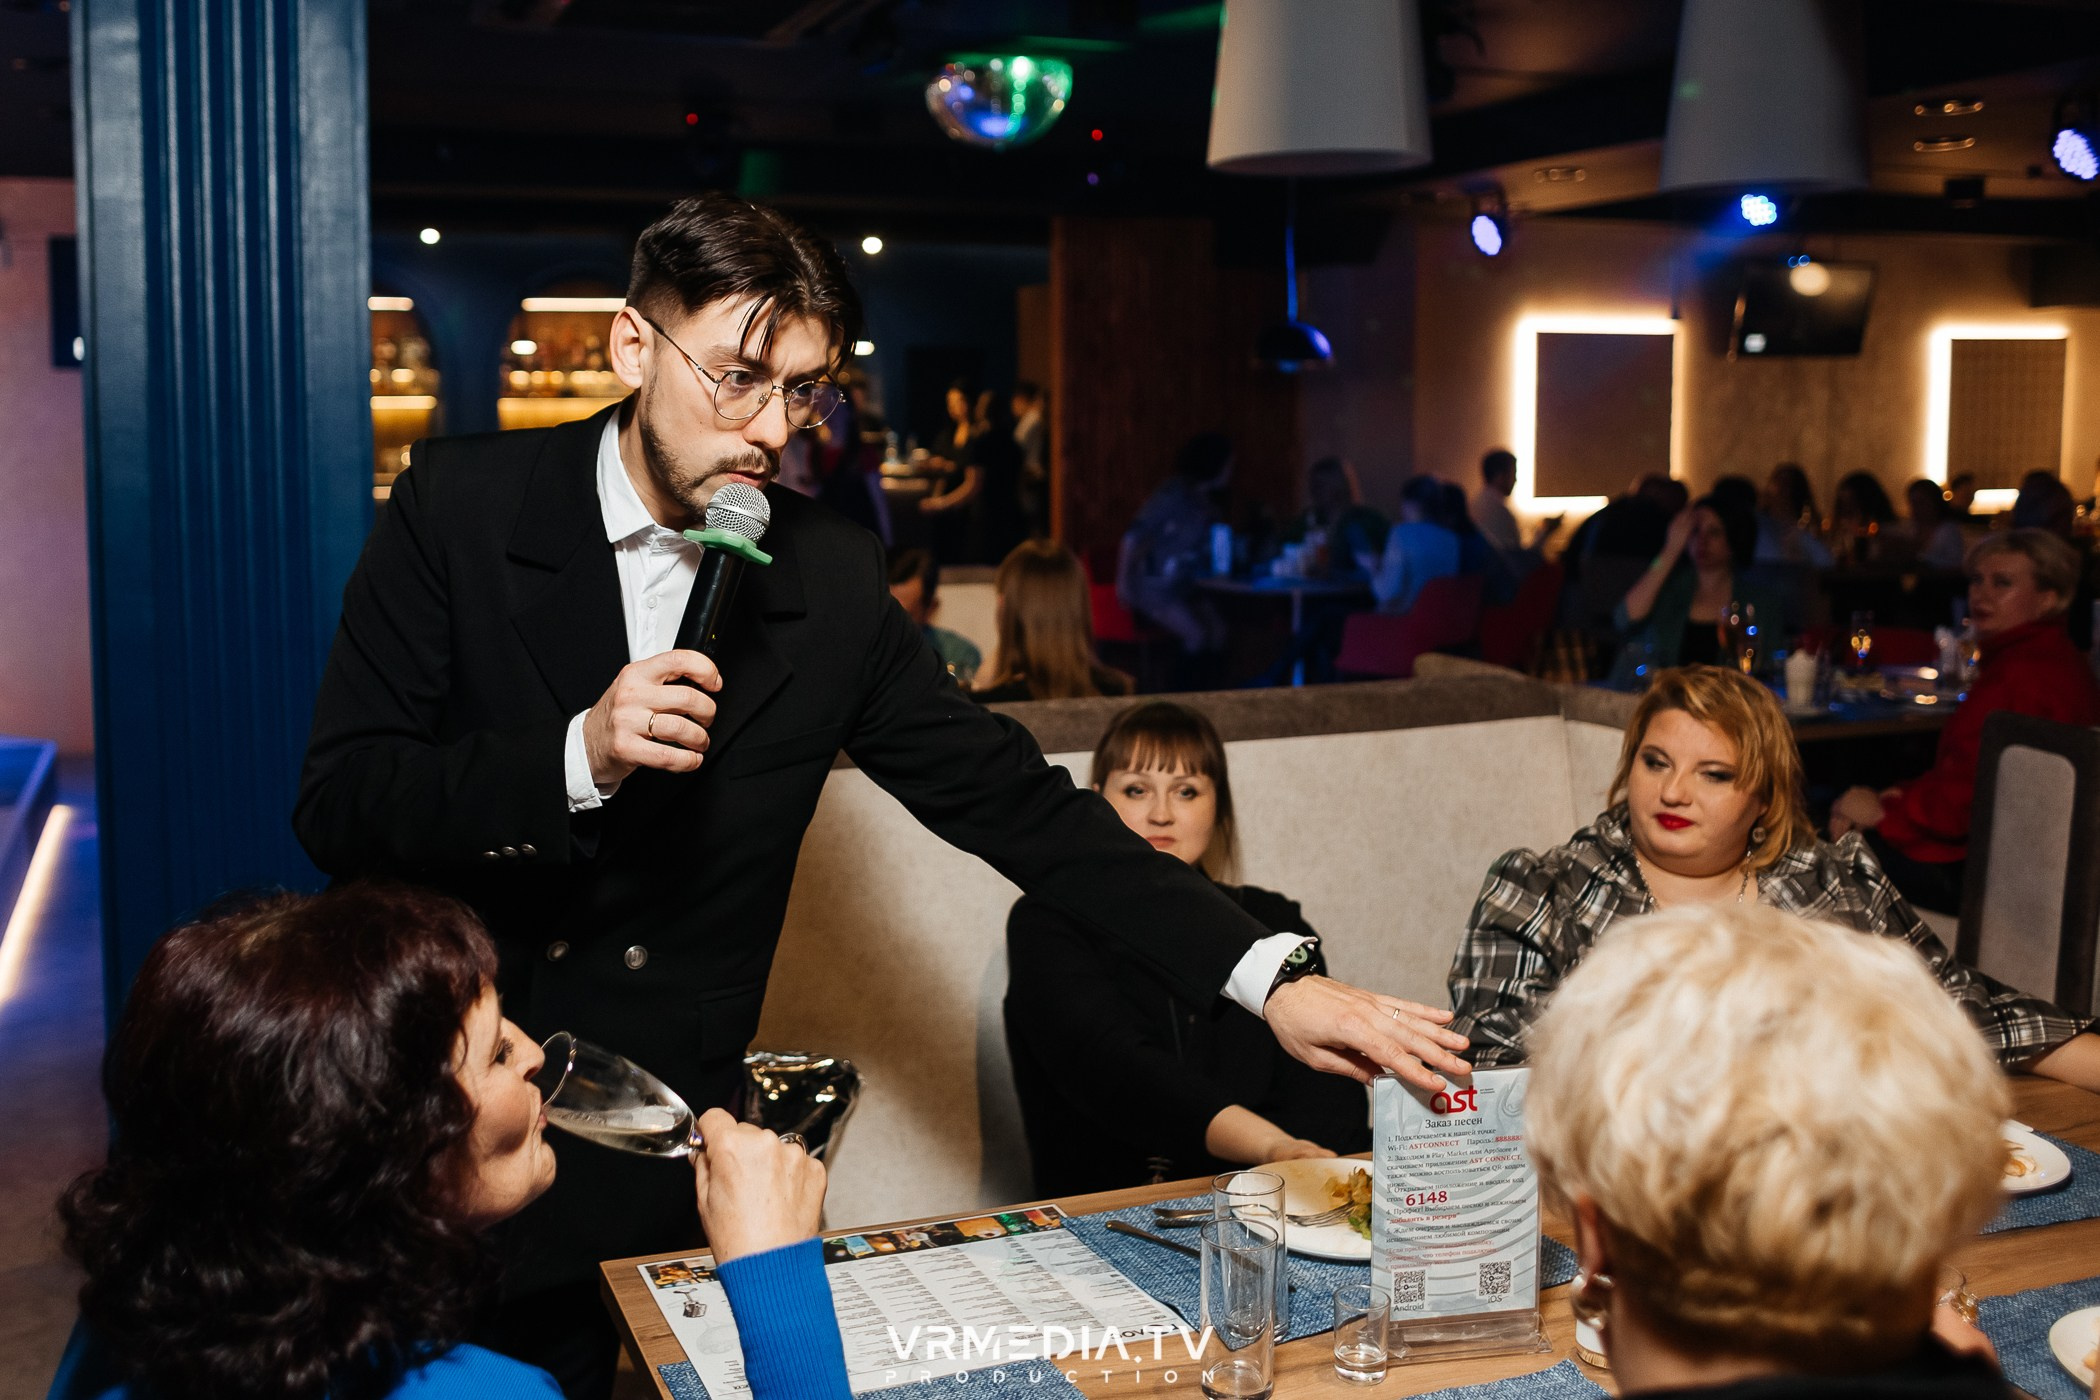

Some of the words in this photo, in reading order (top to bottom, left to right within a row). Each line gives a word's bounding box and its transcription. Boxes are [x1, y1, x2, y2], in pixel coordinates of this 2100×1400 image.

[1425, 1119, 1452, 1129] Заказ
[1454, 1117, 1483, 1127] песен
[1409, 1139, 1460, 1150] ASTCONNECT
[1405, 1190, 1448, 1206] 6148
[1393, 1302, 1425, 1312] Android
